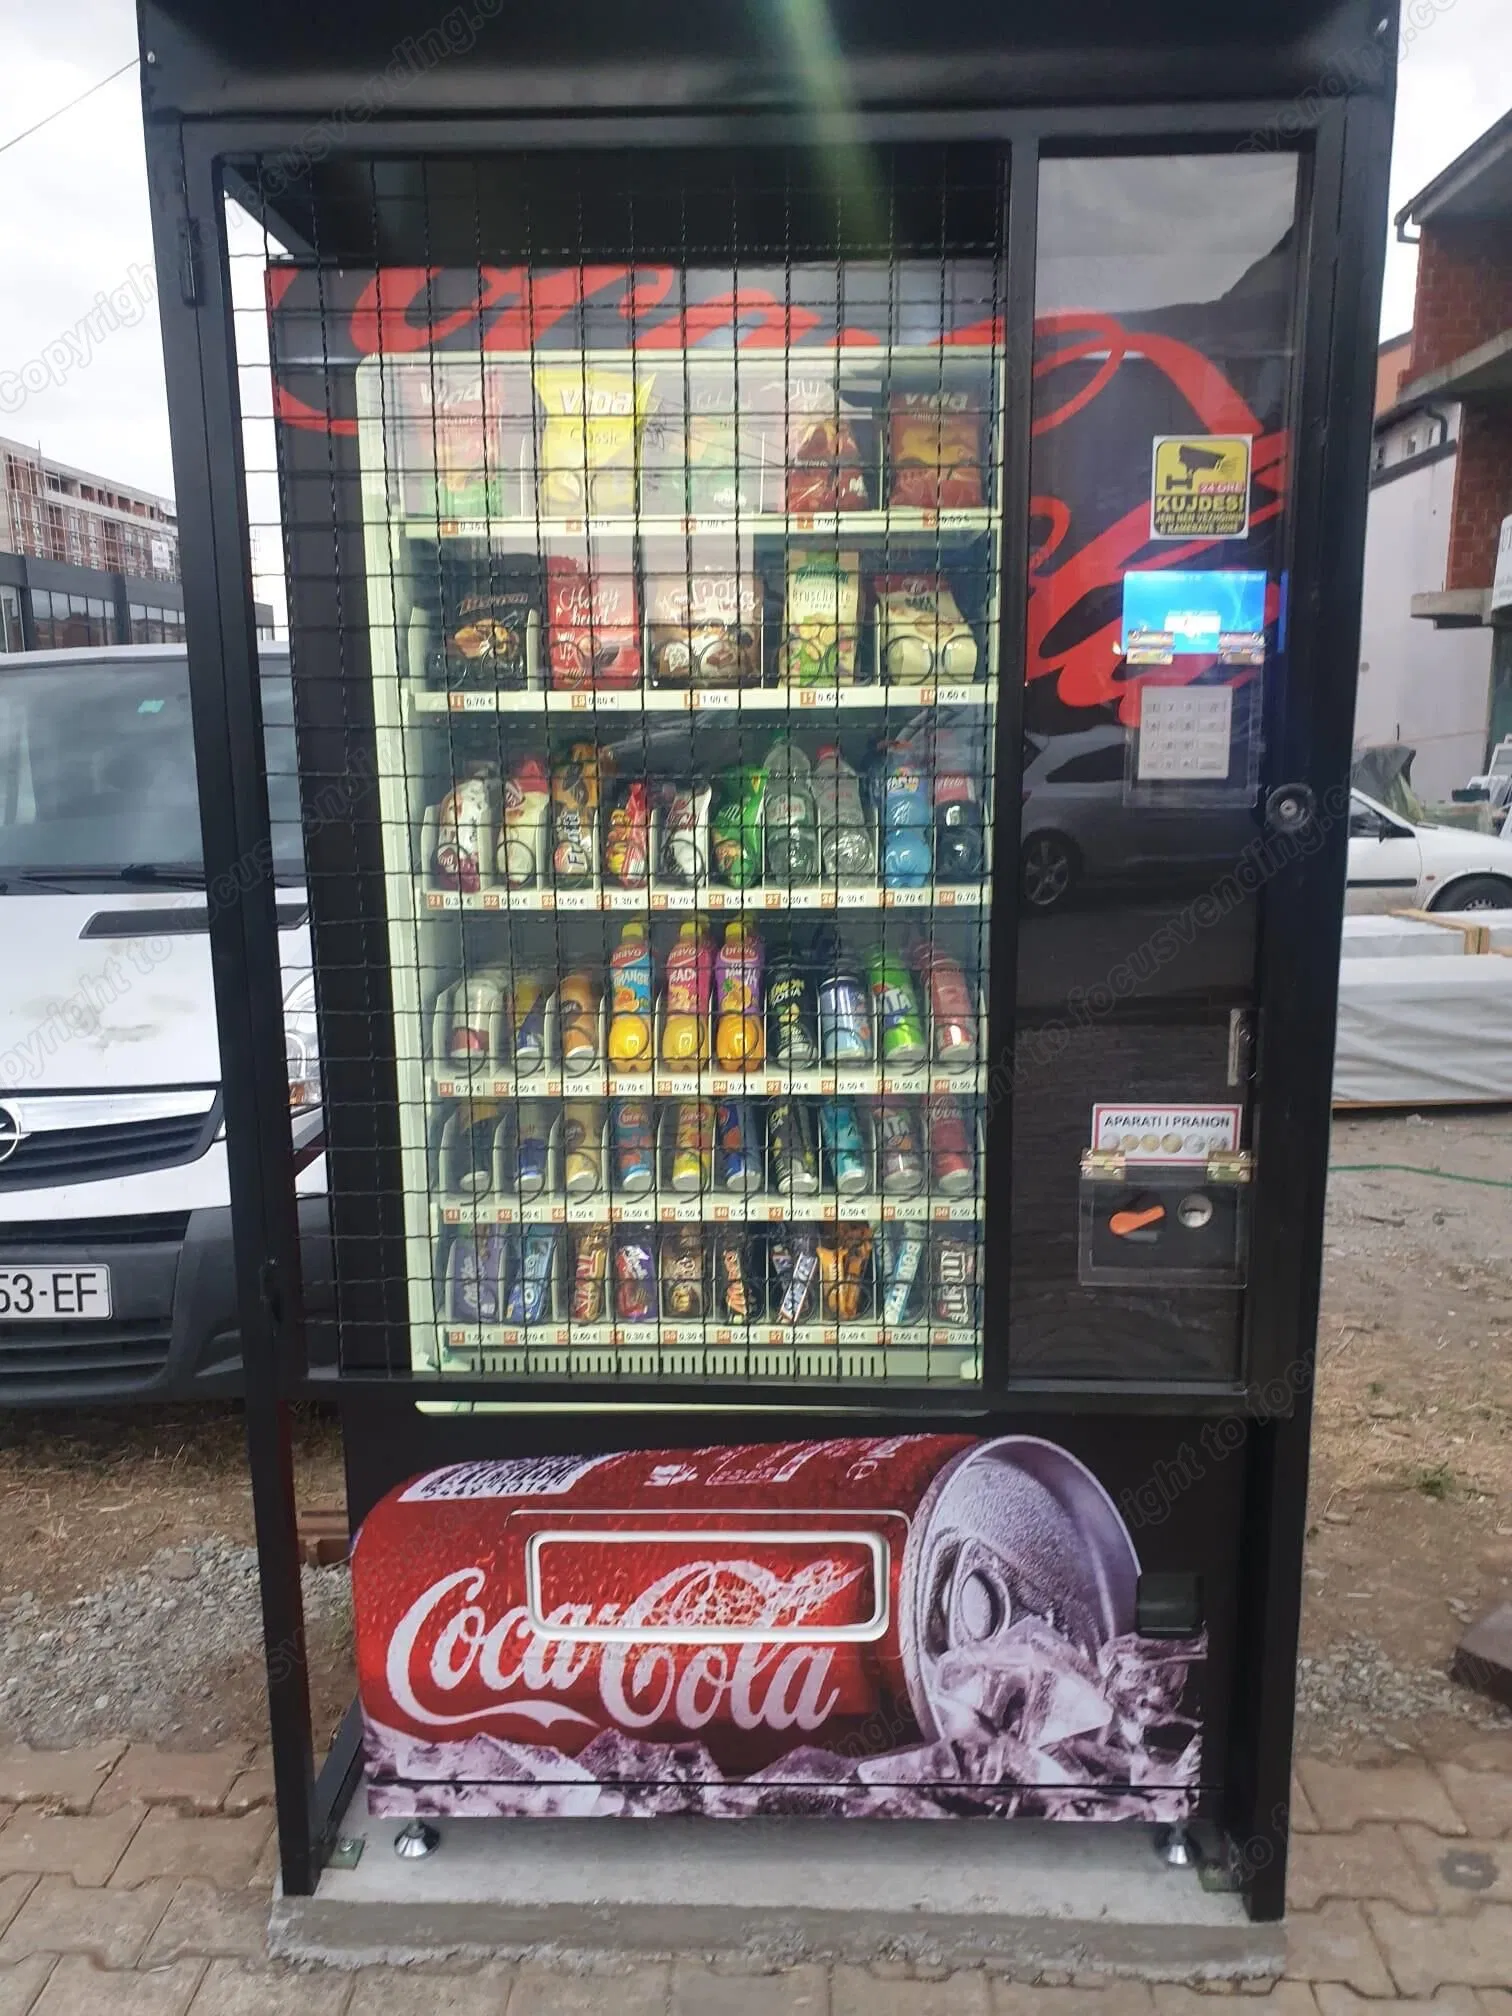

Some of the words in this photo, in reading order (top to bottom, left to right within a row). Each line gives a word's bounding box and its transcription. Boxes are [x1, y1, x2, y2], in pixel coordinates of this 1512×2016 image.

[1156, 496, 1245, 512] KUJDES!
[1105, 1115, 1161, 1128] APARATI
[1172, 1115, 1230, 1128] PRANON
